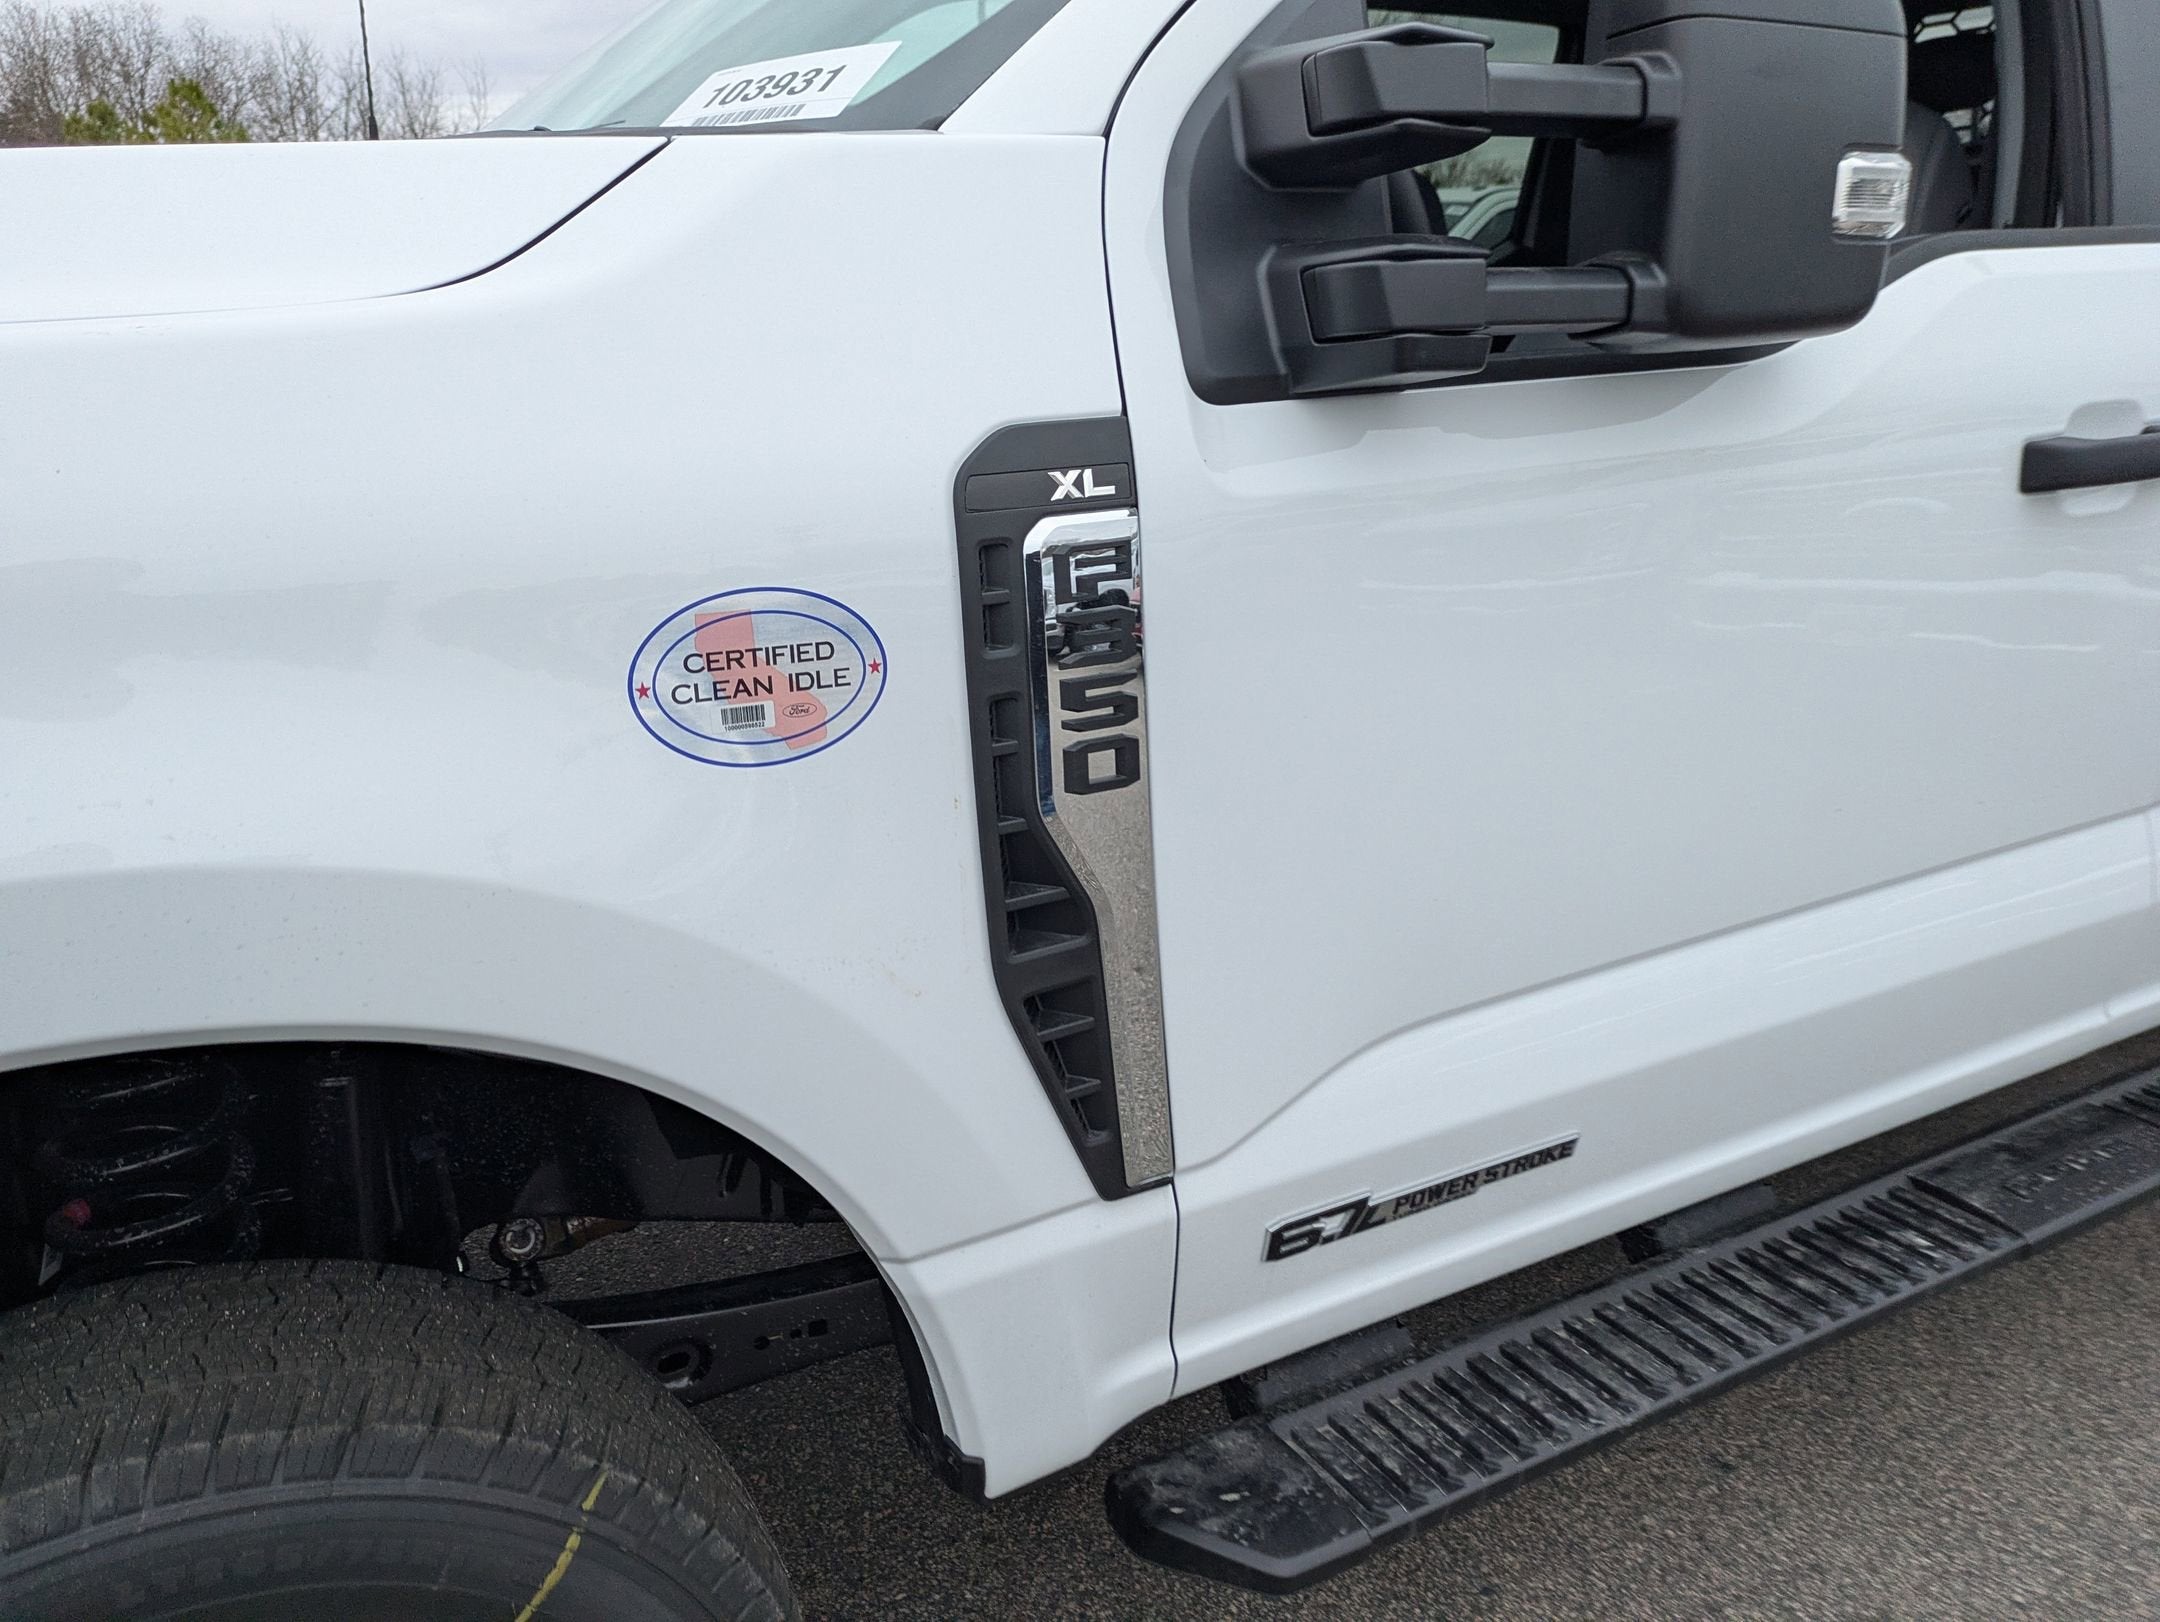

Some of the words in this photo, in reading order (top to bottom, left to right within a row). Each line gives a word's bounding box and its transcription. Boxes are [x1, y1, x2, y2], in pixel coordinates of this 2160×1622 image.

[703, 64, 848, 109] 103931
[1047, 468, 1116, 501] XL
[682, 640, 836, 674] CERTIFIED
[670, 674, 774, 705] CLEAN
[788, 667, 852, 693] IDLE
[788, 703, 812, 716] Ford
[1261, 1194, 1388, 1262] 6.7L
[1391, 1174, 1479, 1214] POWER
[1481, 1142, 1576, 1185] STROKE
